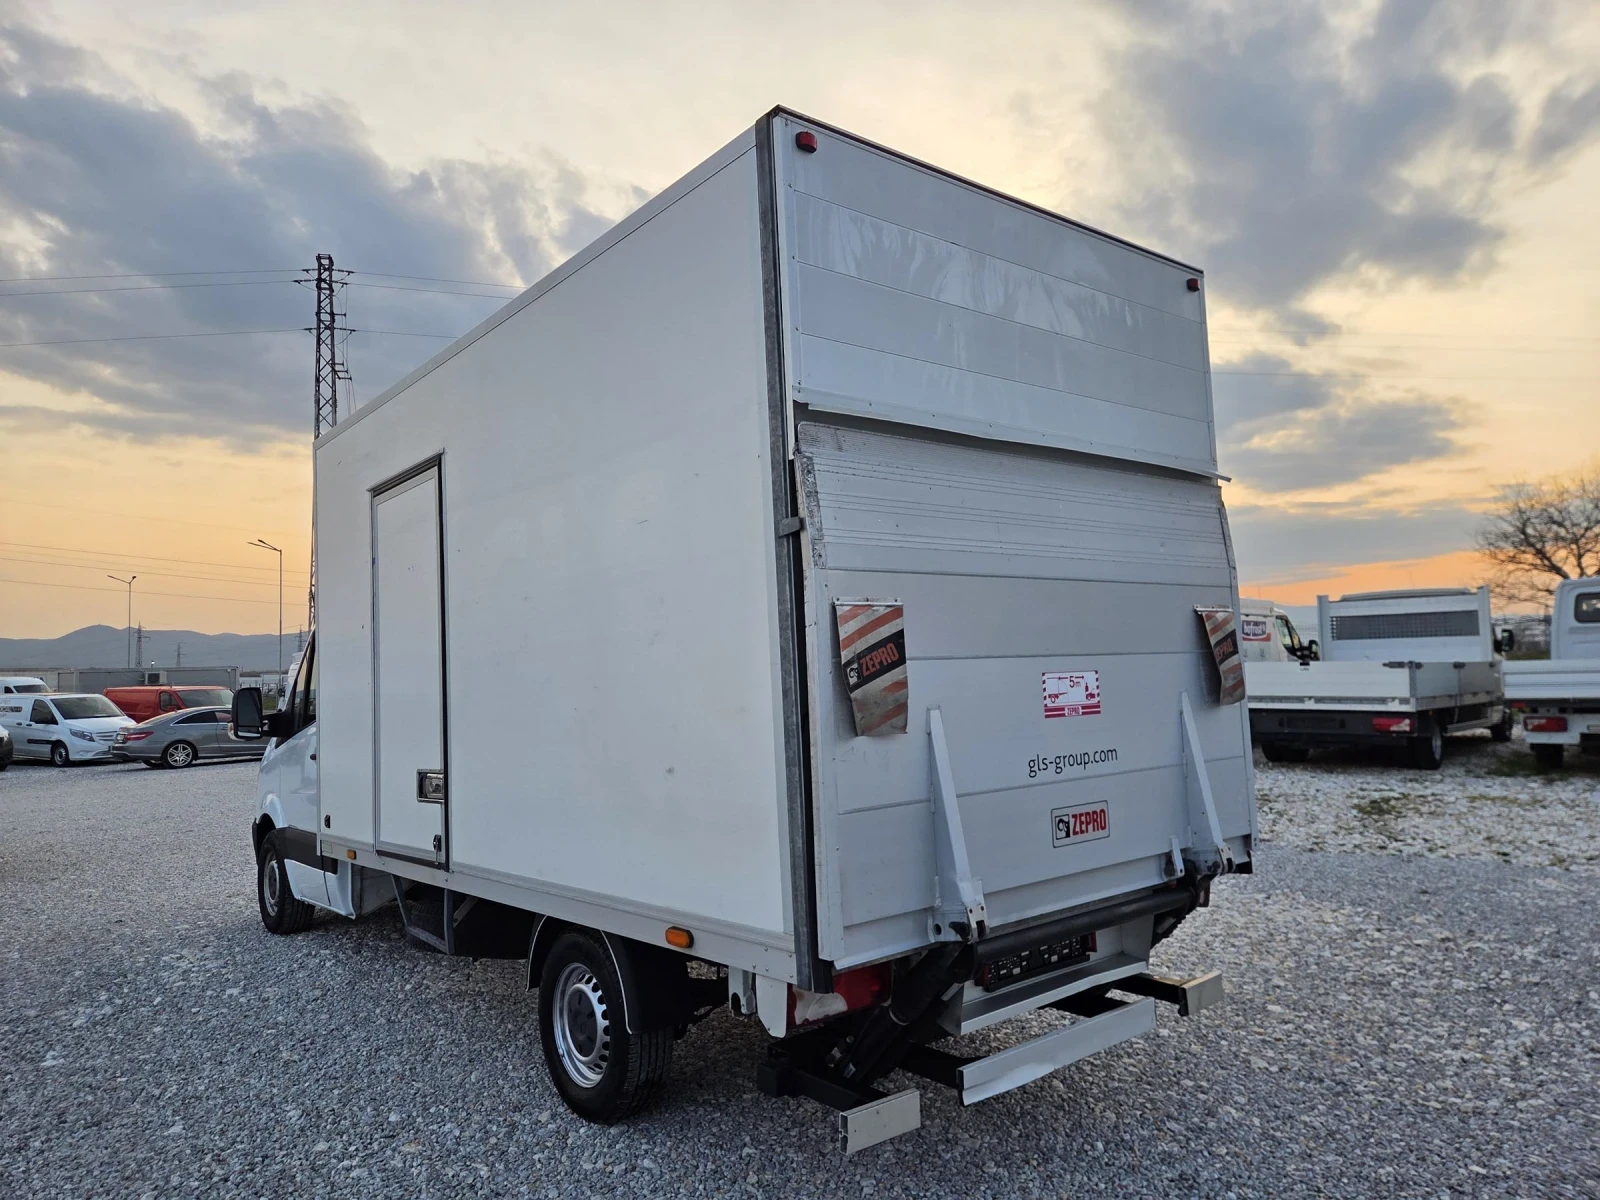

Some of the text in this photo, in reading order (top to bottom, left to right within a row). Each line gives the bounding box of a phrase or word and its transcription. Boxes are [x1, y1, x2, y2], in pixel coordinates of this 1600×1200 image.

[859, 642, 899, 677] ZEPRO
[1028, 748, 1118, 778] gls-group.com
[1071, 808, 1107, 836] ZEPRO
